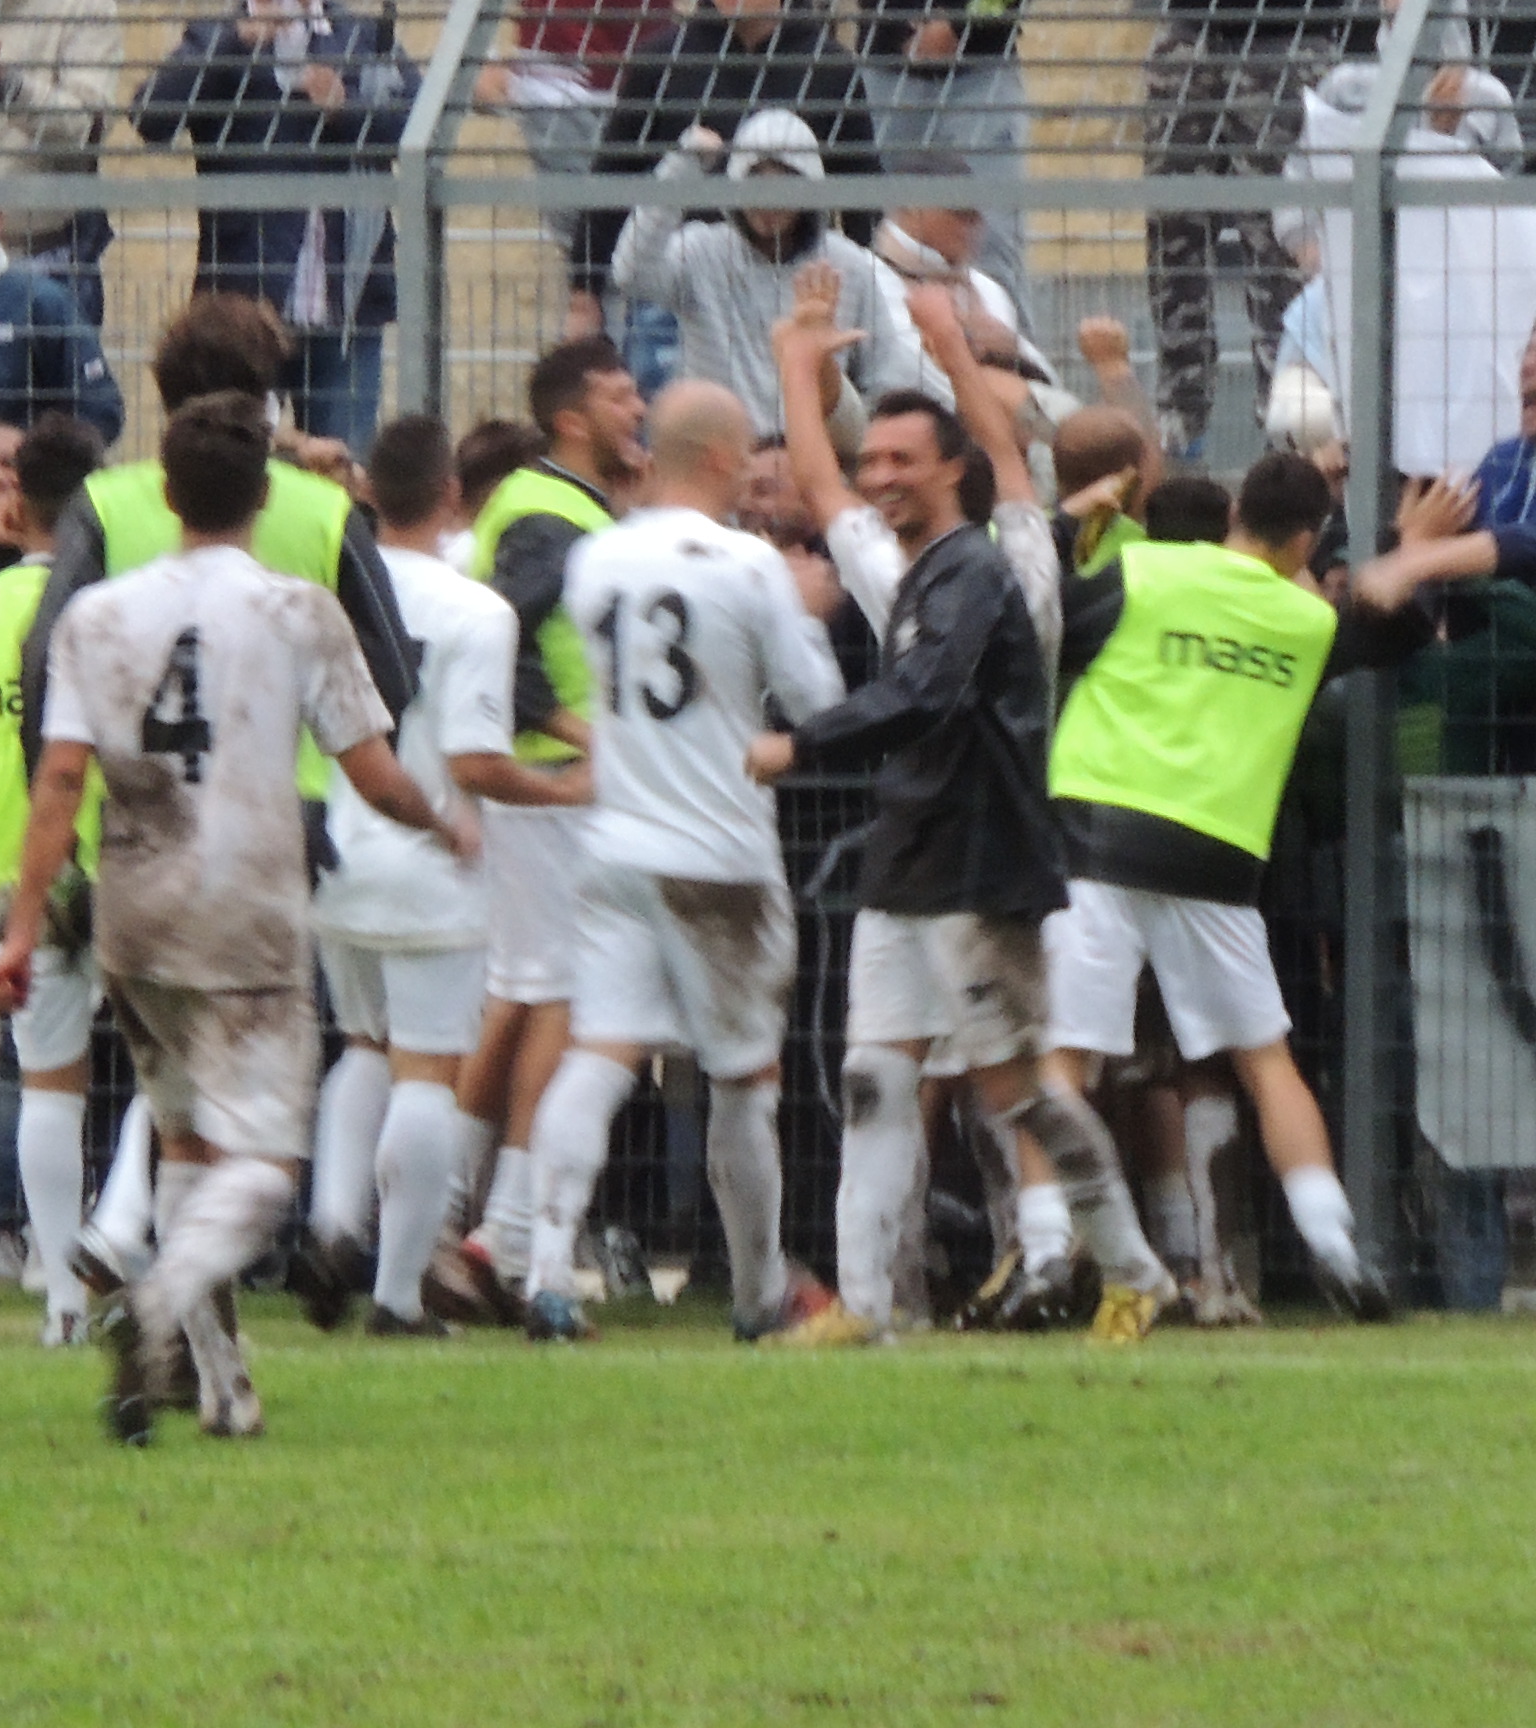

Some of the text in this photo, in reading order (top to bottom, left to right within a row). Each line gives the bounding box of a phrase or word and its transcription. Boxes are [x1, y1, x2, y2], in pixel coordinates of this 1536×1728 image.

[141, 626, 212, 783] 4
[592, 588, 704, 722] 13
[1158, 628, 1298, 689] mass
